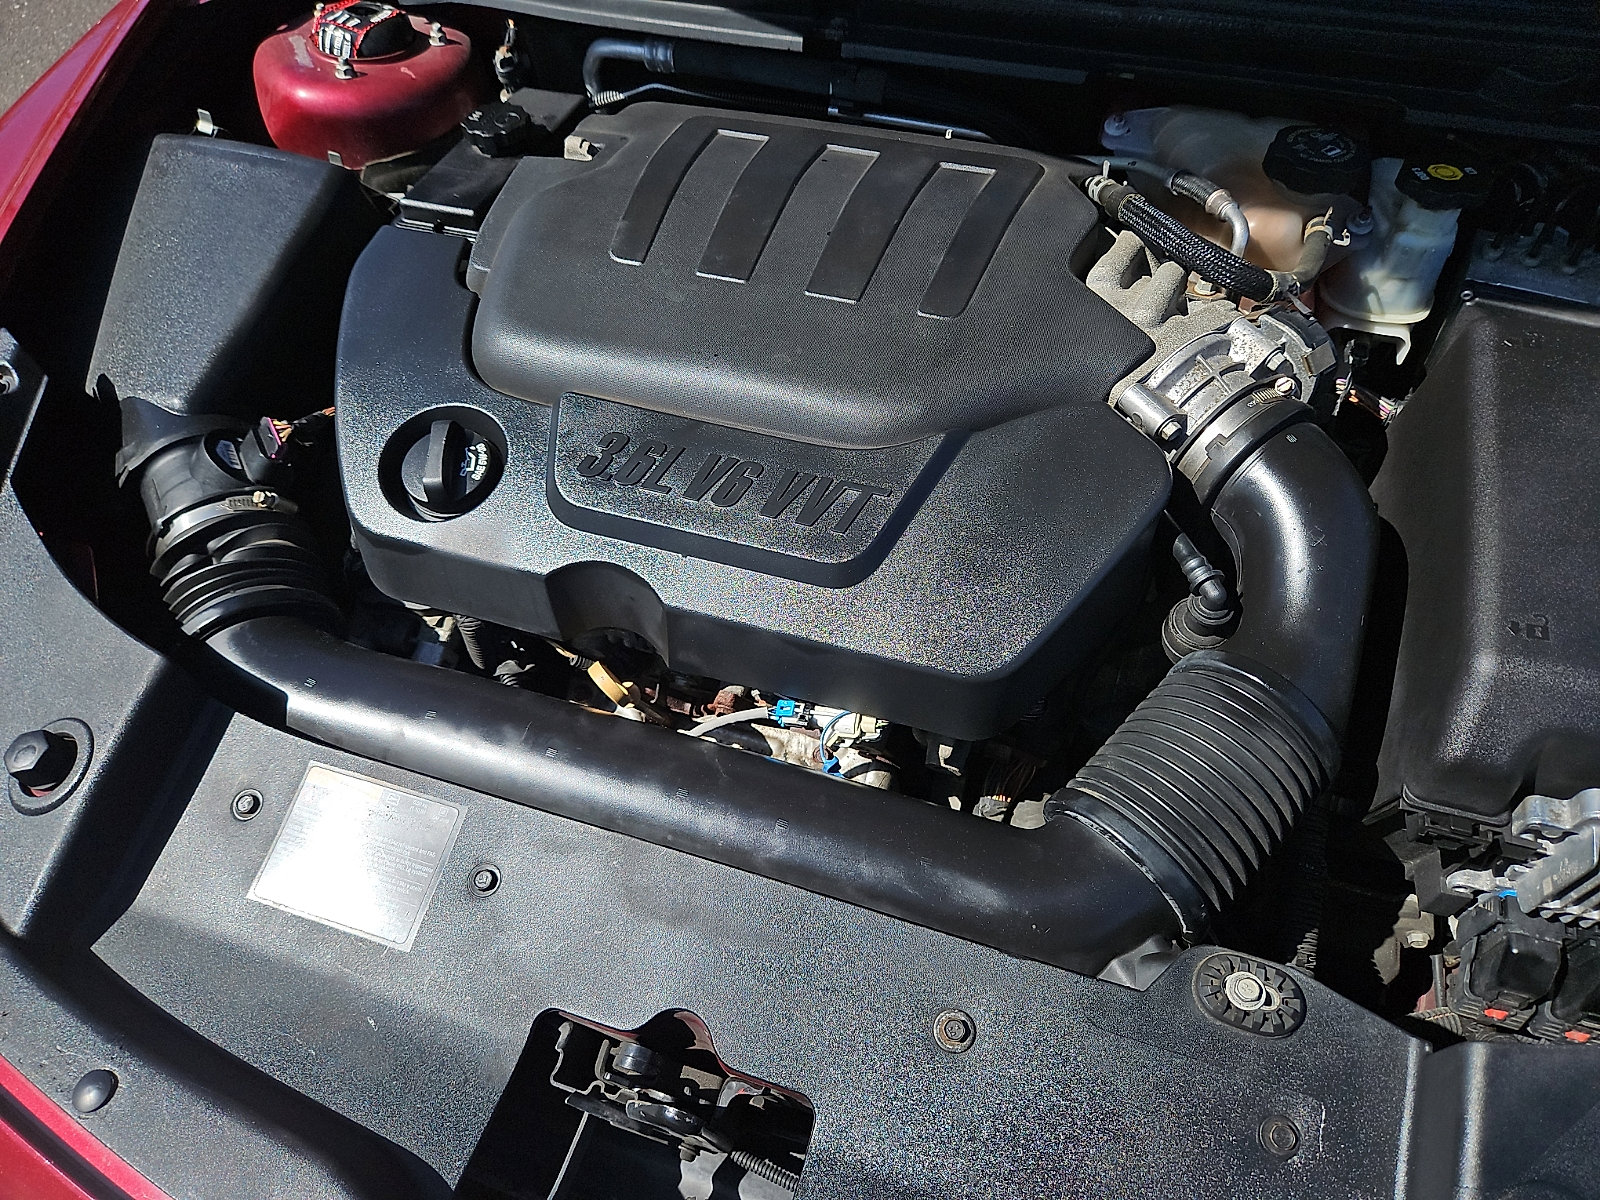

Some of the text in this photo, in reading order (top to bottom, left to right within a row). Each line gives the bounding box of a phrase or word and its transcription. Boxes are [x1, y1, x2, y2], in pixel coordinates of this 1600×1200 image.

[576, 431, 893, 534] 3.6L V6 VVT
